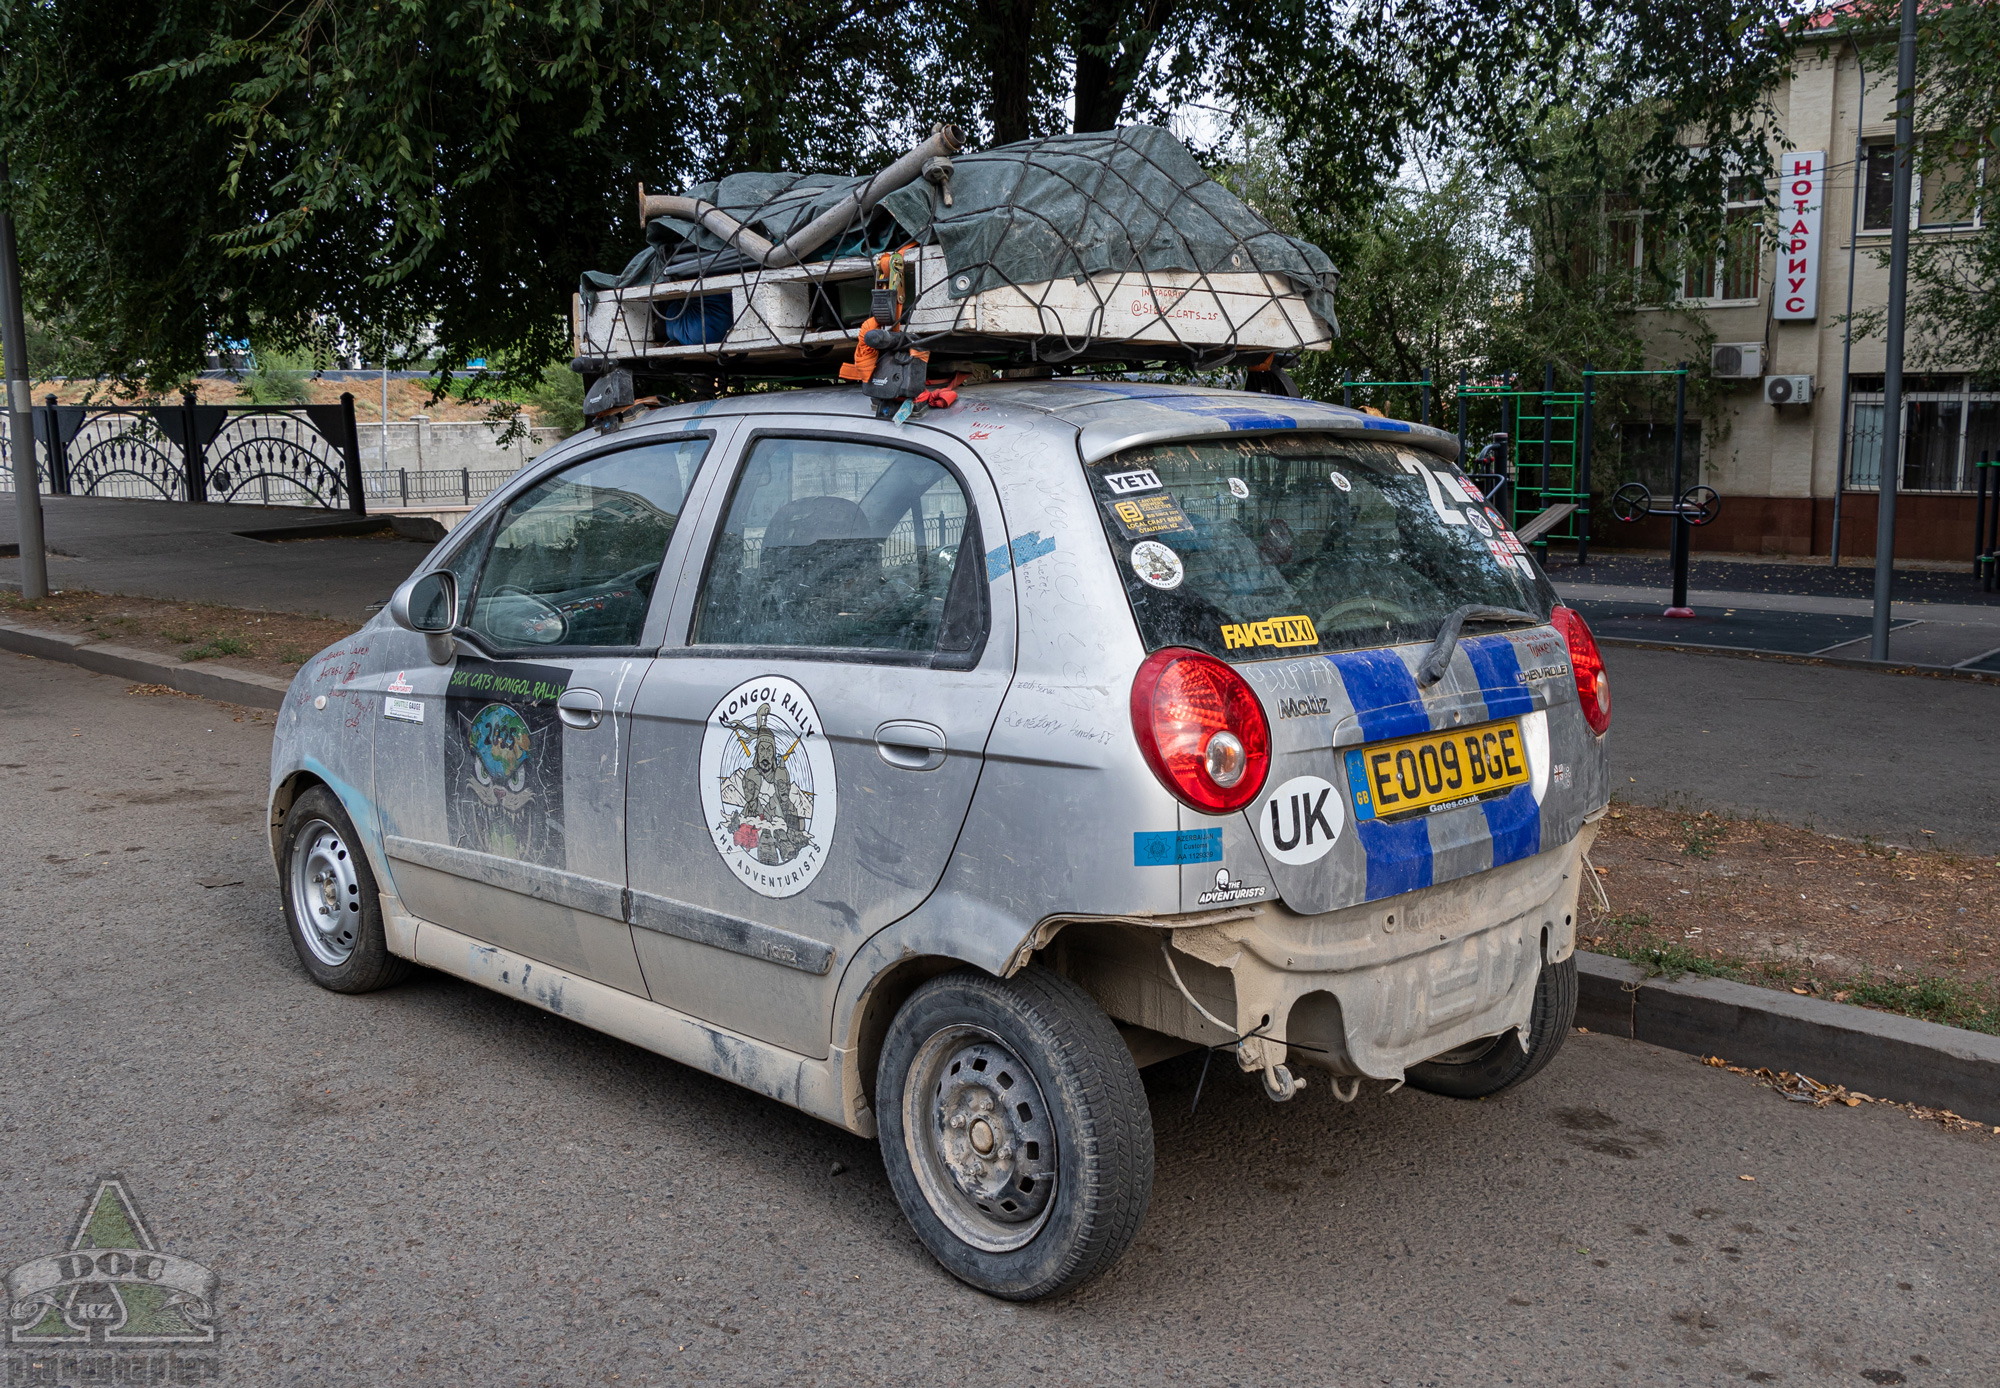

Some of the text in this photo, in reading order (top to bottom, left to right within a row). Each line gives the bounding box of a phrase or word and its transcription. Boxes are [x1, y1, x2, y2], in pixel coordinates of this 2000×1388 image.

[1785, 160, 1812, 313] НОТАРИУС
[1141, 288, 1186, 299] INTAGRAM
[1109, 473, 1157, 490] YETI
[1126, 521, 1147, 530] LOCAL
[1516, 665, 1569, 684] CHEVROLET
[451, 671, 566, 702] SICK CATS MONGOL RALLY
[718, 687, 815, 738] MONGOL RALLY
[1277, 694, 1331, 719] Matiz
[1464, 729, 1523, 786] BGE
[1356, 790, 1370, 806] GB
[1429, 794, 1480, 813] Gates.co.uk
[1270, 787, 1335, 852] UK
[1176, 833, 1214, 842] AZERBAIJAN
[715, 825, 821, 888] THE ADVENTURISTS
[1228, 881, 1241, 889] THE
[1198, 886, 1265, 904] ADVENTURISTS
[761, 940, 798, 965] Matiz
